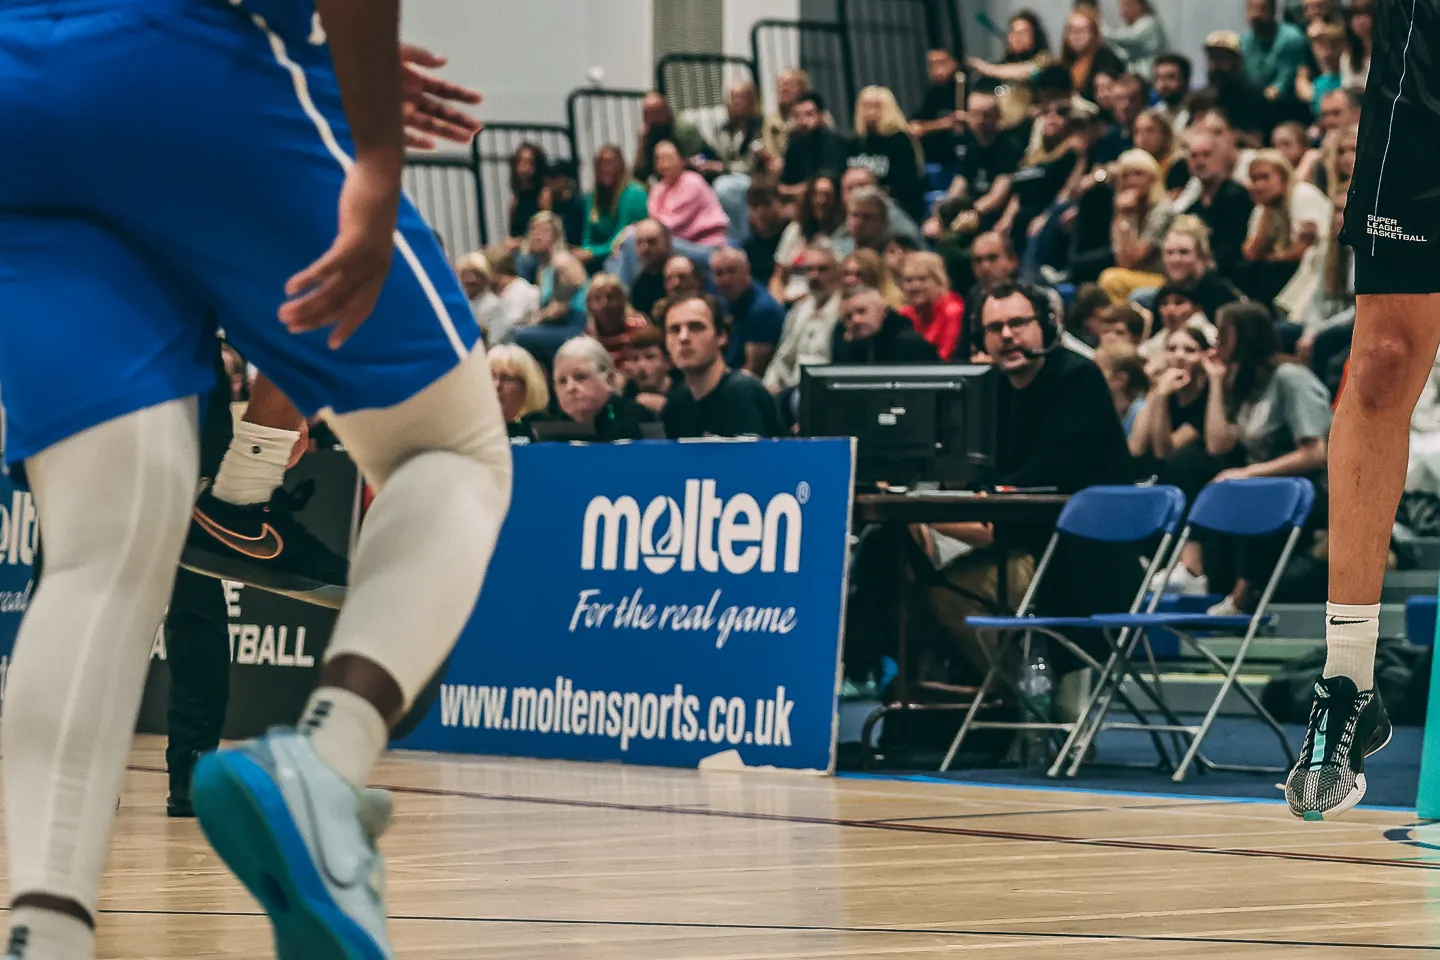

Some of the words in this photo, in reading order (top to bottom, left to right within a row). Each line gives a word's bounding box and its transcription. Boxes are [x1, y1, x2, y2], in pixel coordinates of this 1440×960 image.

[1366, 221, 1403, 233] LEAGUE
[1367, 214, 1398, 226] SUPER
[1366, 227, 1428, 242] BASKETBALL
[568, 588, 614, 632] For
[613, 587, 658, 630] the
[658, 588, 721, 631] real
[715, 606, 798, 649] game
[440, 675, 795, 751] www.moltensports.co.uk
